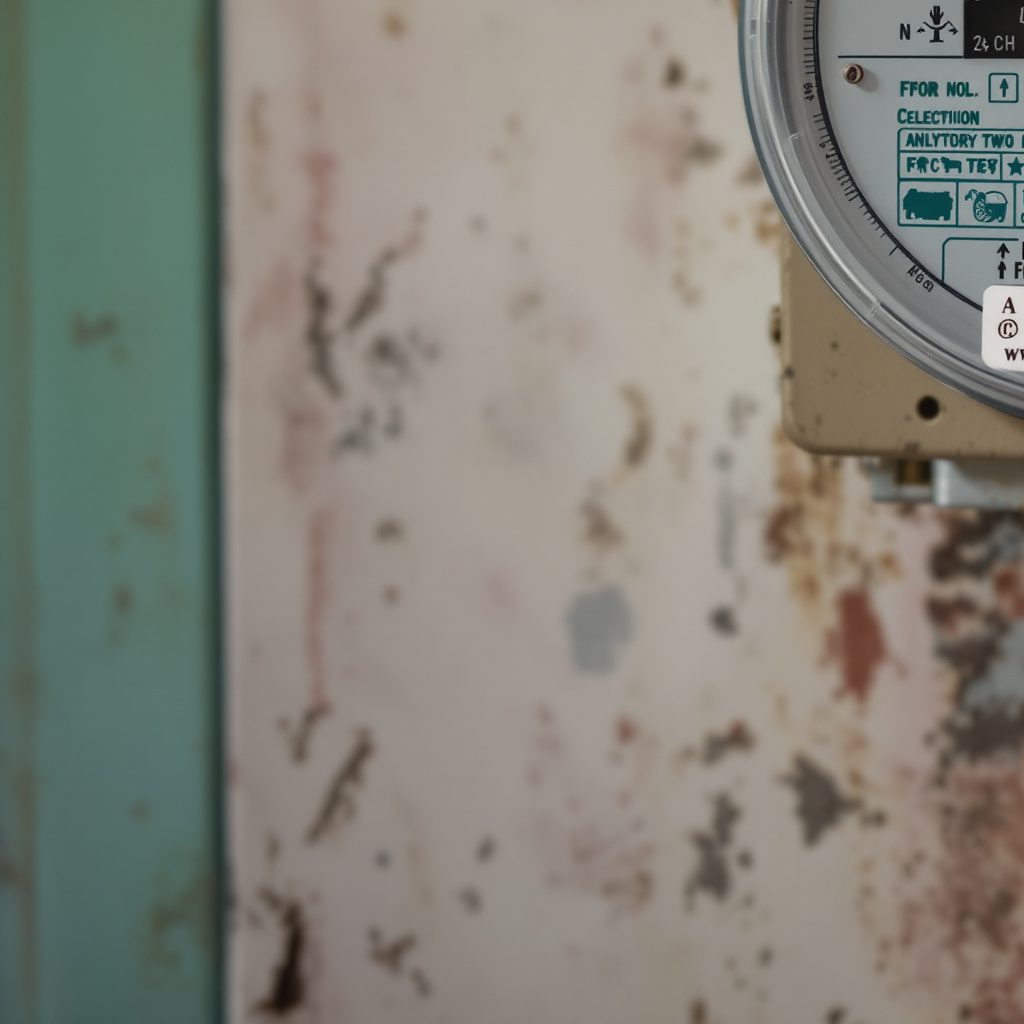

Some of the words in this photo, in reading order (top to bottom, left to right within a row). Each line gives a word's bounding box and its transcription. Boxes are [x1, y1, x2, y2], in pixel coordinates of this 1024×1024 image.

[900, 23, 911, 40] N
[993, 35, 1015, 51] CH
[899, 81, 939, 97] FFOR
[982, 134, 1015, 149] TWO
[1001, 296, 1016, 314] A
